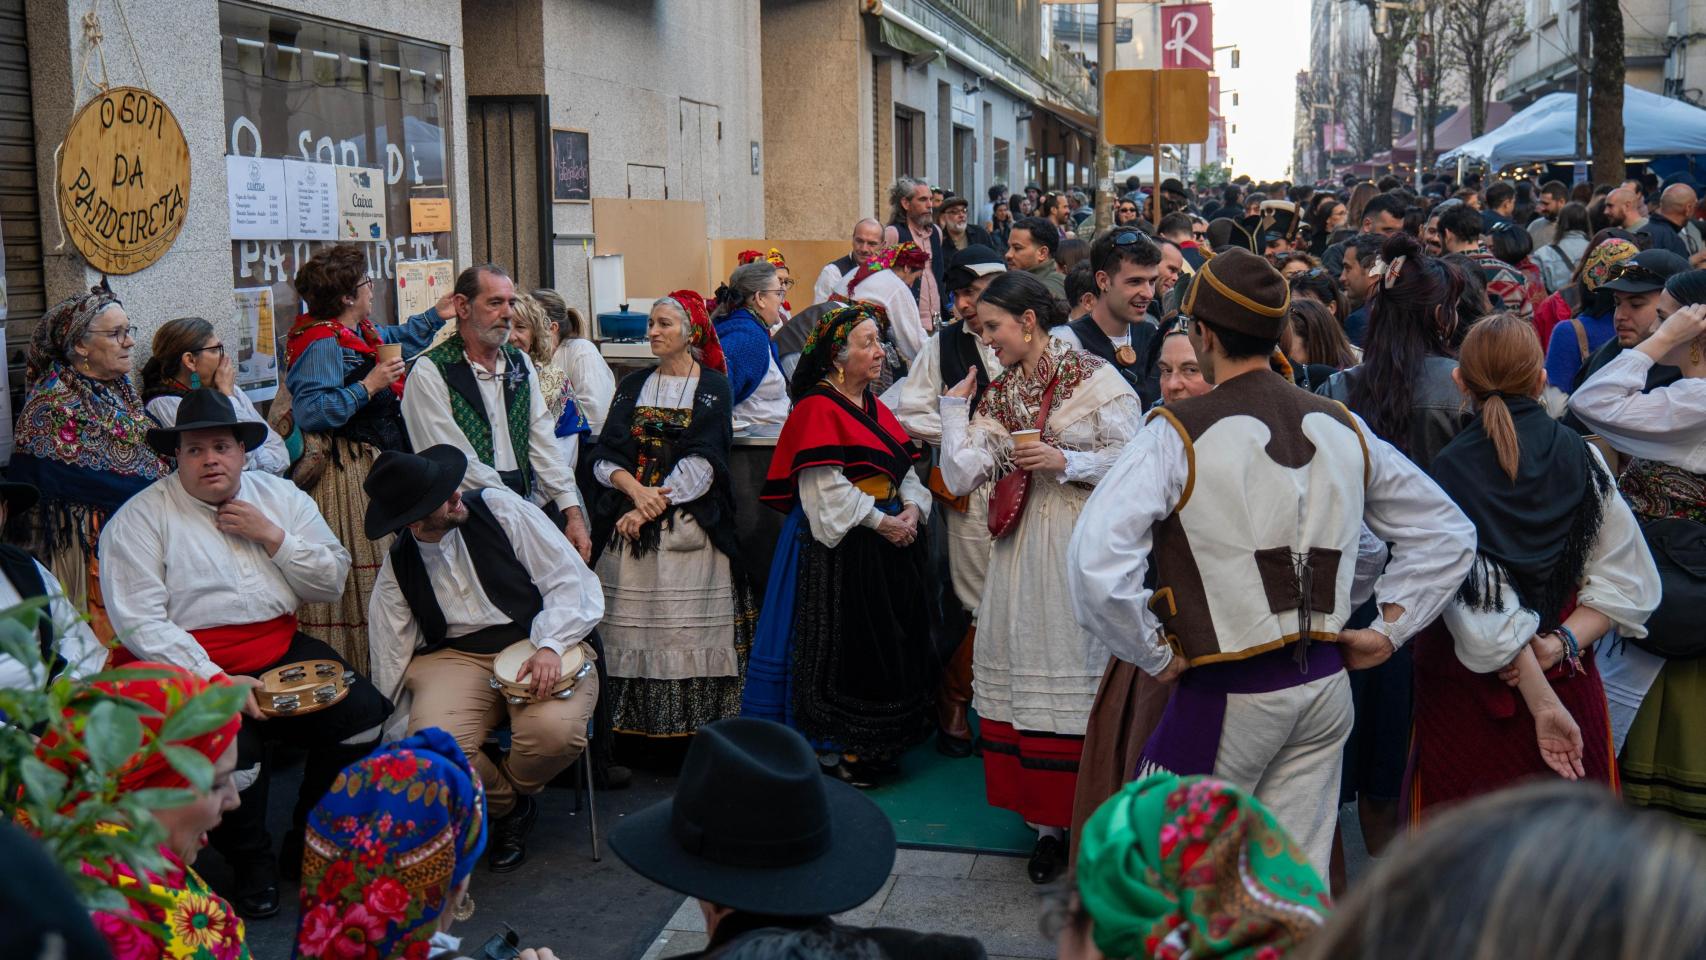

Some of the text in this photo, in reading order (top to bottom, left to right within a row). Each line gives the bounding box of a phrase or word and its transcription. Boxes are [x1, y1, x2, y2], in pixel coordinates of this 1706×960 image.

[1164, 12, 1211, 65] R
[101, 97, 115, 129] O
[231, 116, 262, 158] O
[112, 153, 144, 189] DA
[69, 166, 184, 244] PANDEIRETA
[240, 236, 438, 281] PANIRETA
